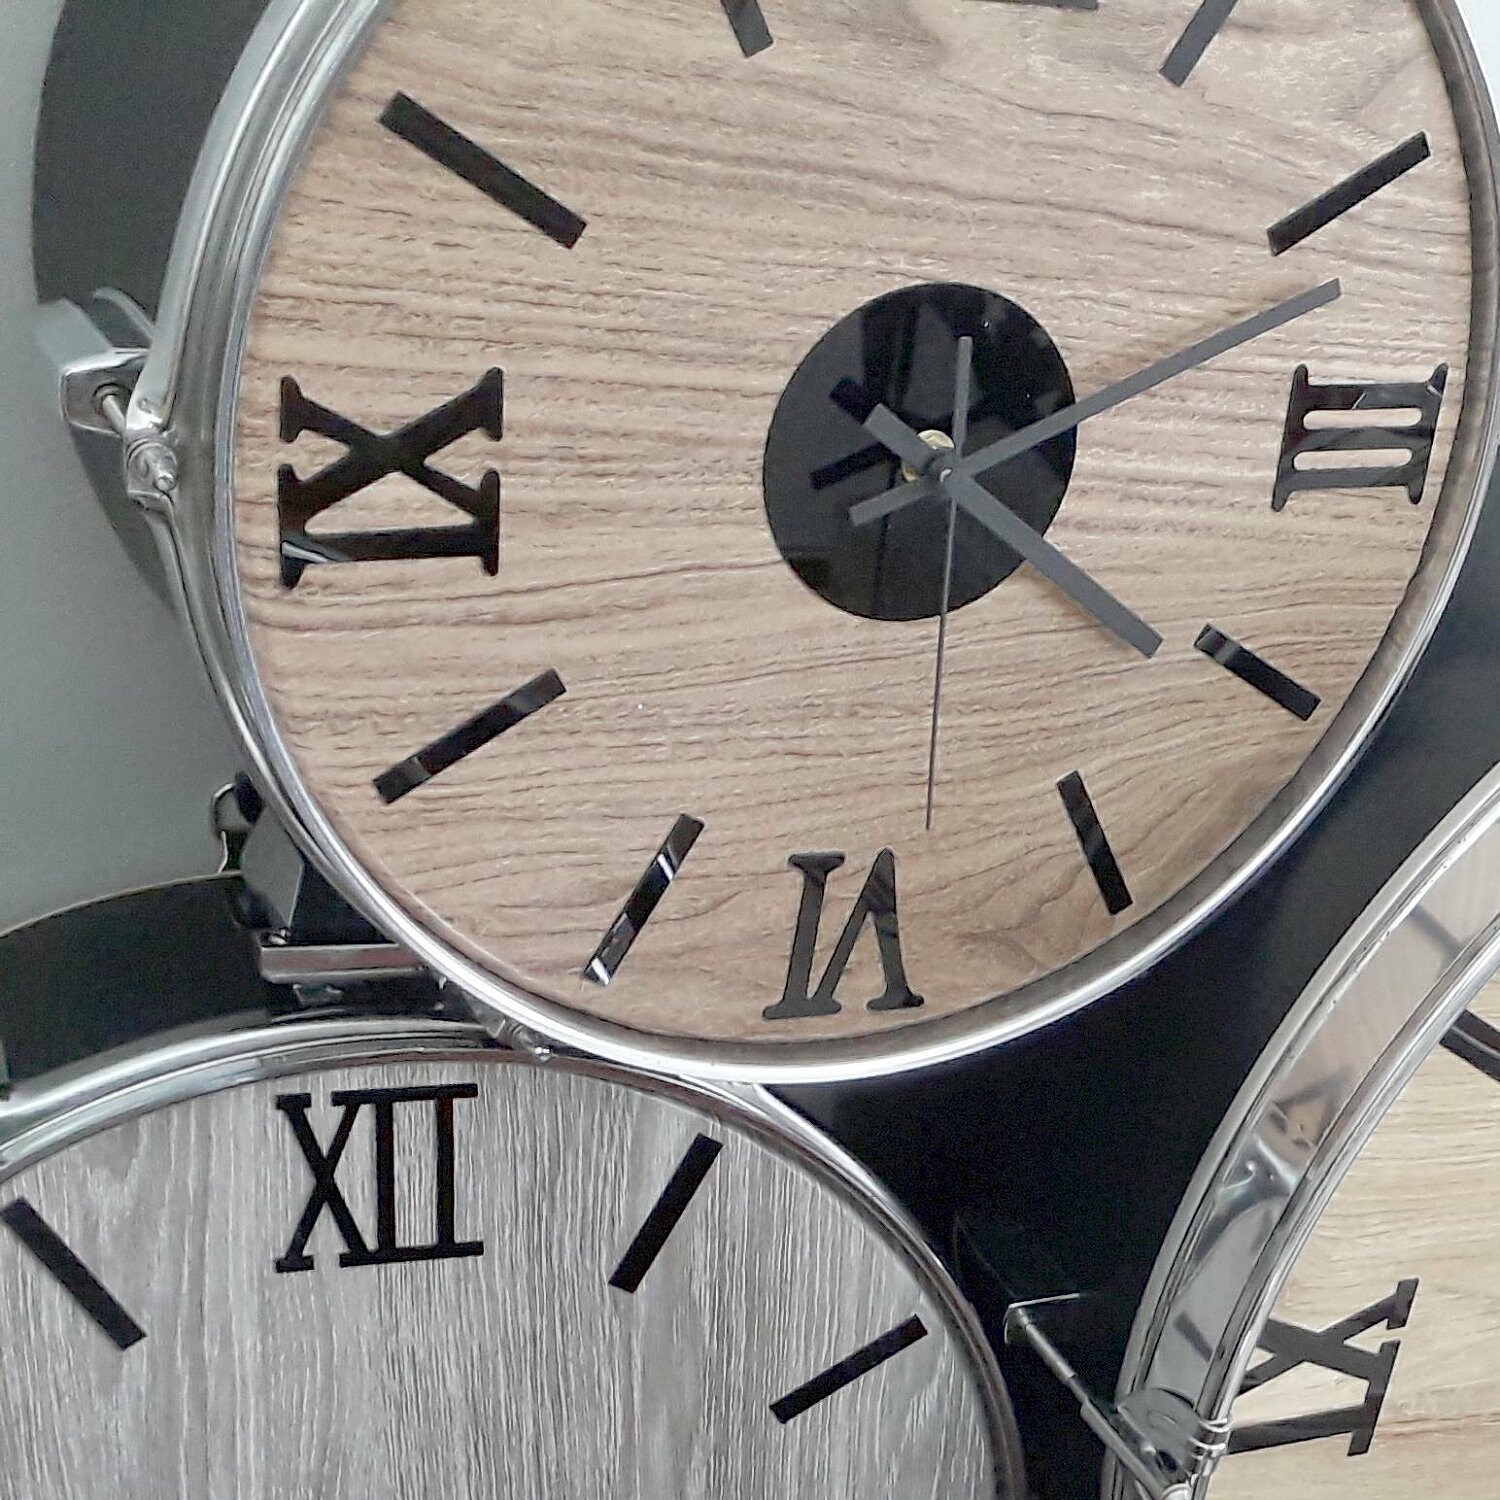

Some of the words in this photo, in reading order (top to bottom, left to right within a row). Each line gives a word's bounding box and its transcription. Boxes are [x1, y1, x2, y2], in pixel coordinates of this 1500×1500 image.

[278, 366, 503, 589] IX
[1271, 363, 1449, 512] III
[762, 848, 925, 1020] VI
[275, 1083, 484, 1273] XII
[1227, 1278, 1419, 1456] IX
